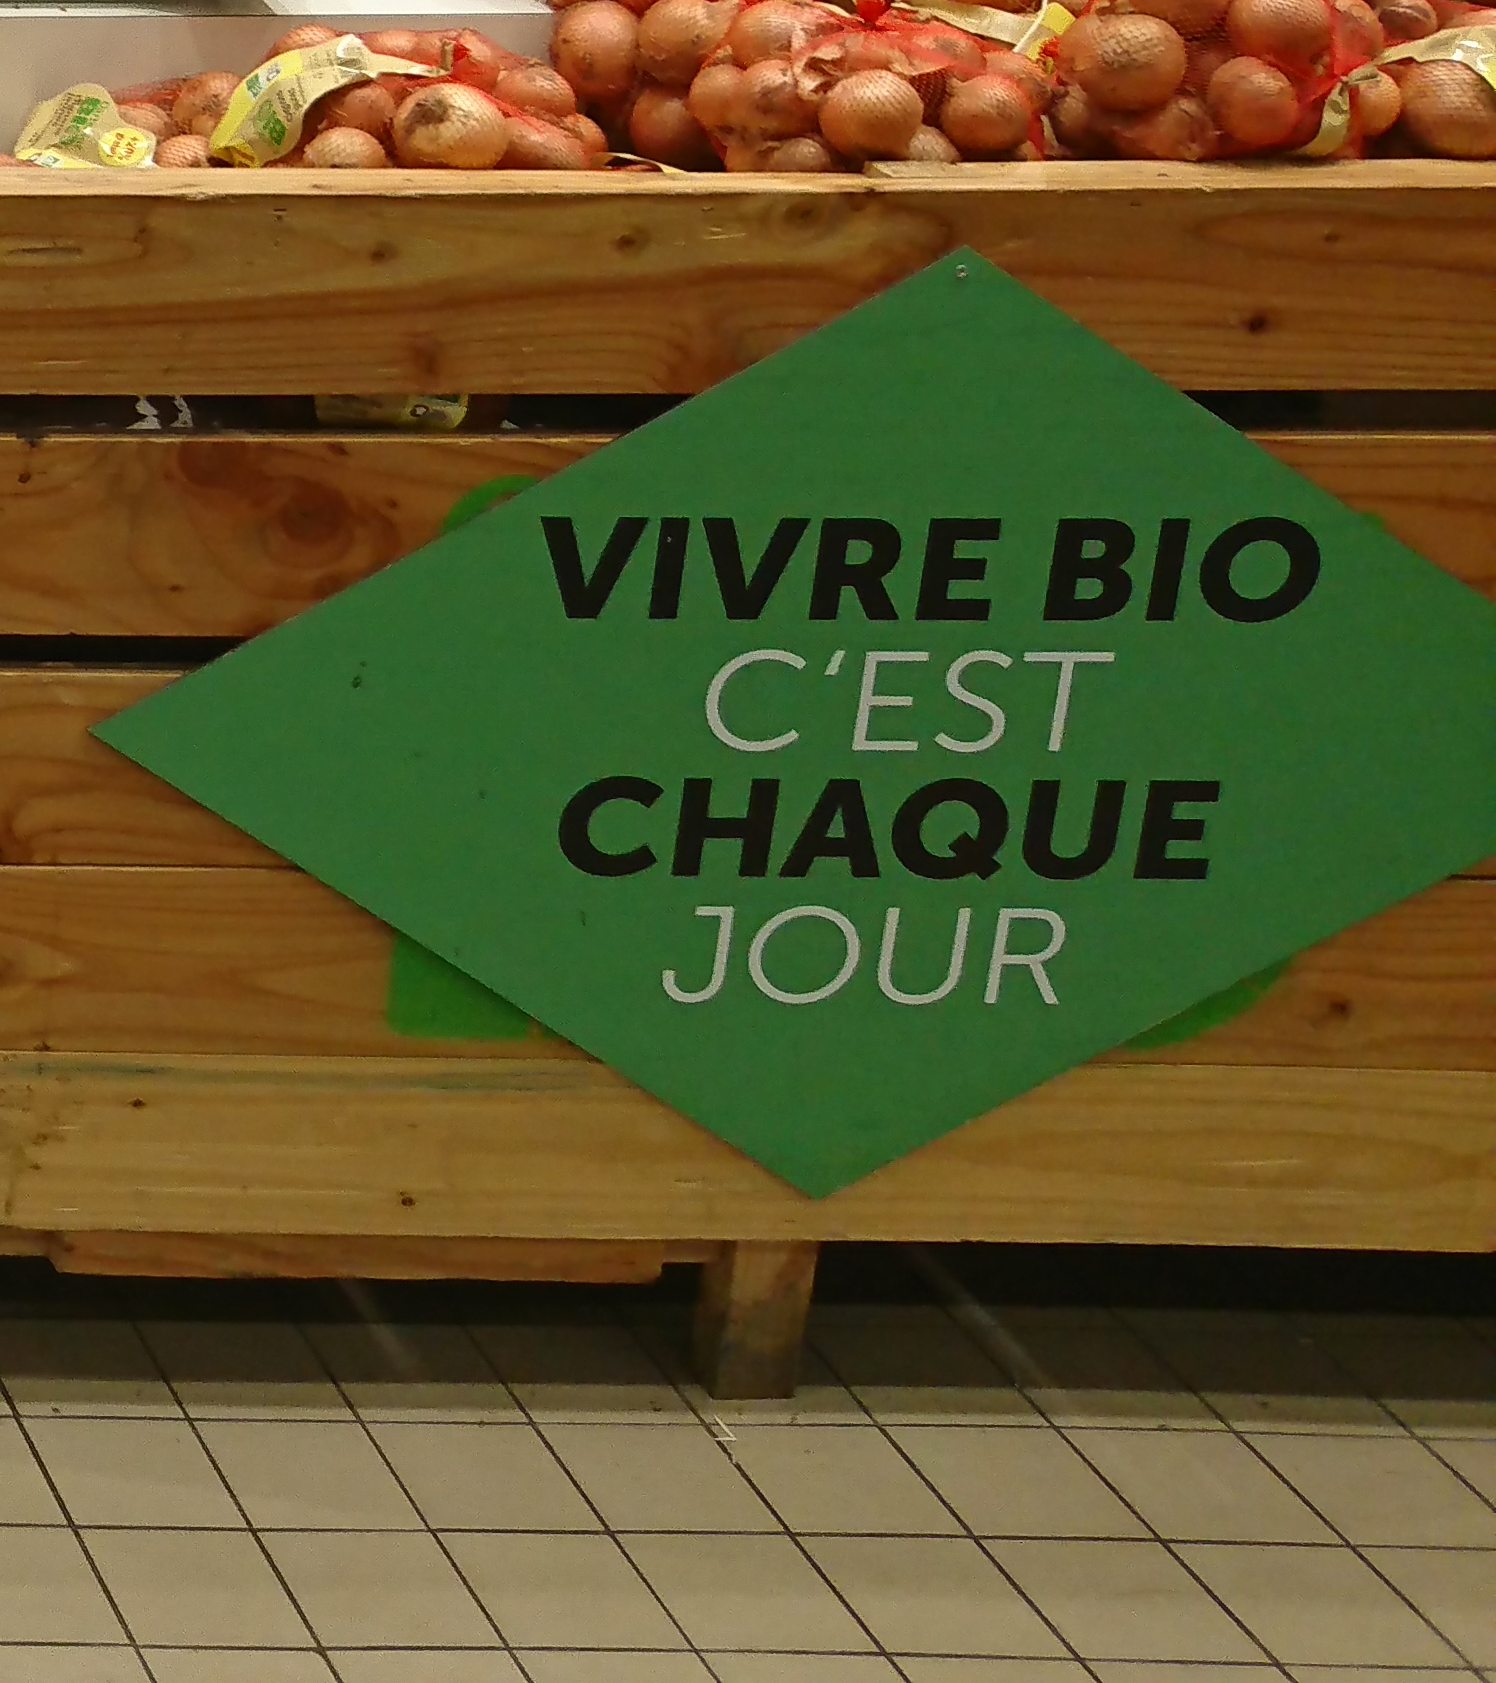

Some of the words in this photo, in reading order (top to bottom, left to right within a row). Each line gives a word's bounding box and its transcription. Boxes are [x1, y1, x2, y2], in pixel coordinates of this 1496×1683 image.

[539, 516, 1004, 624] VIVRE
[1041, 516, 1323, 625] BIO
[703, 649, 1117, 755] C'EST
[556, 775, 1221, 883] CHAQUE
[661, 905, 1068, 1007] JOUR
